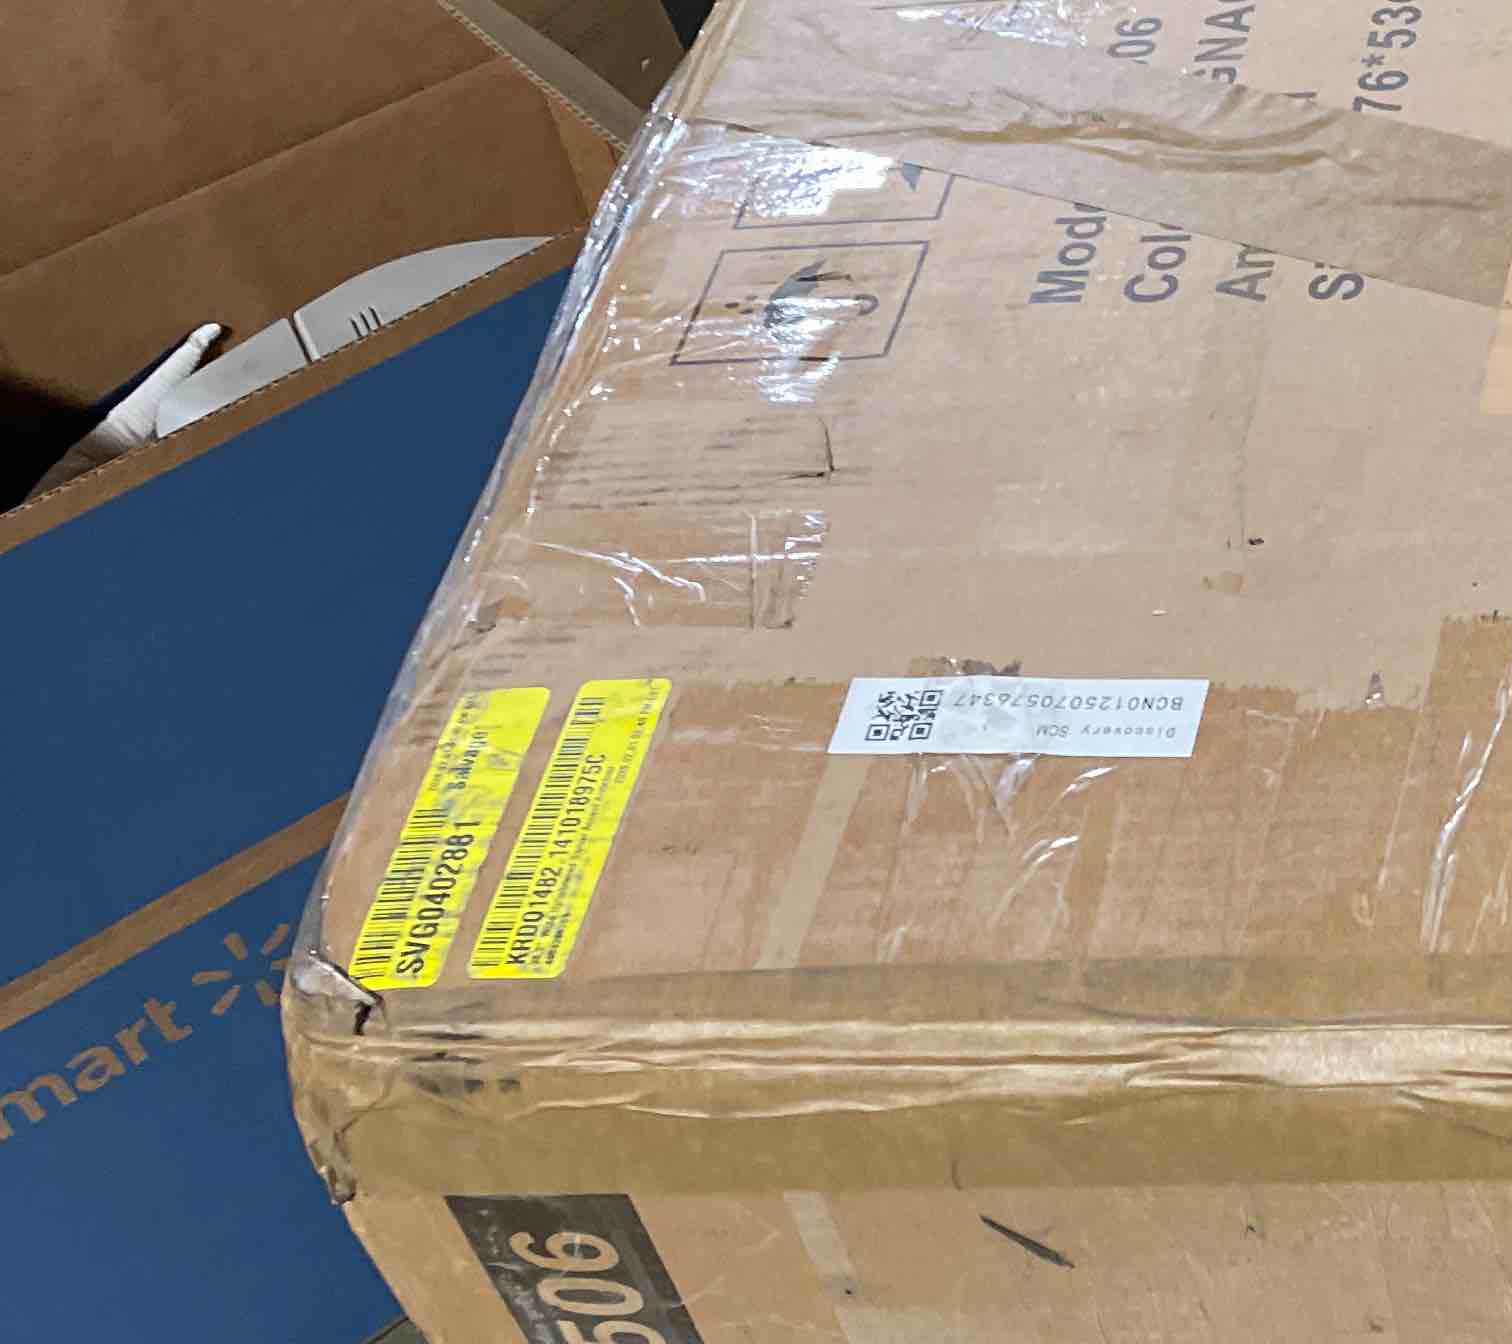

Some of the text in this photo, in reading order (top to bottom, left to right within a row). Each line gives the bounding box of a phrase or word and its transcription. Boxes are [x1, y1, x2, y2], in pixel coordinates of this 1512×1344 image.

[1028, 16, 1163, 304] Mod 06
[1124, 223, 1192, 303] Col
[1035, 723, 1176, 740] Discovery SCM
[0, 996, 193, 1142] mart
